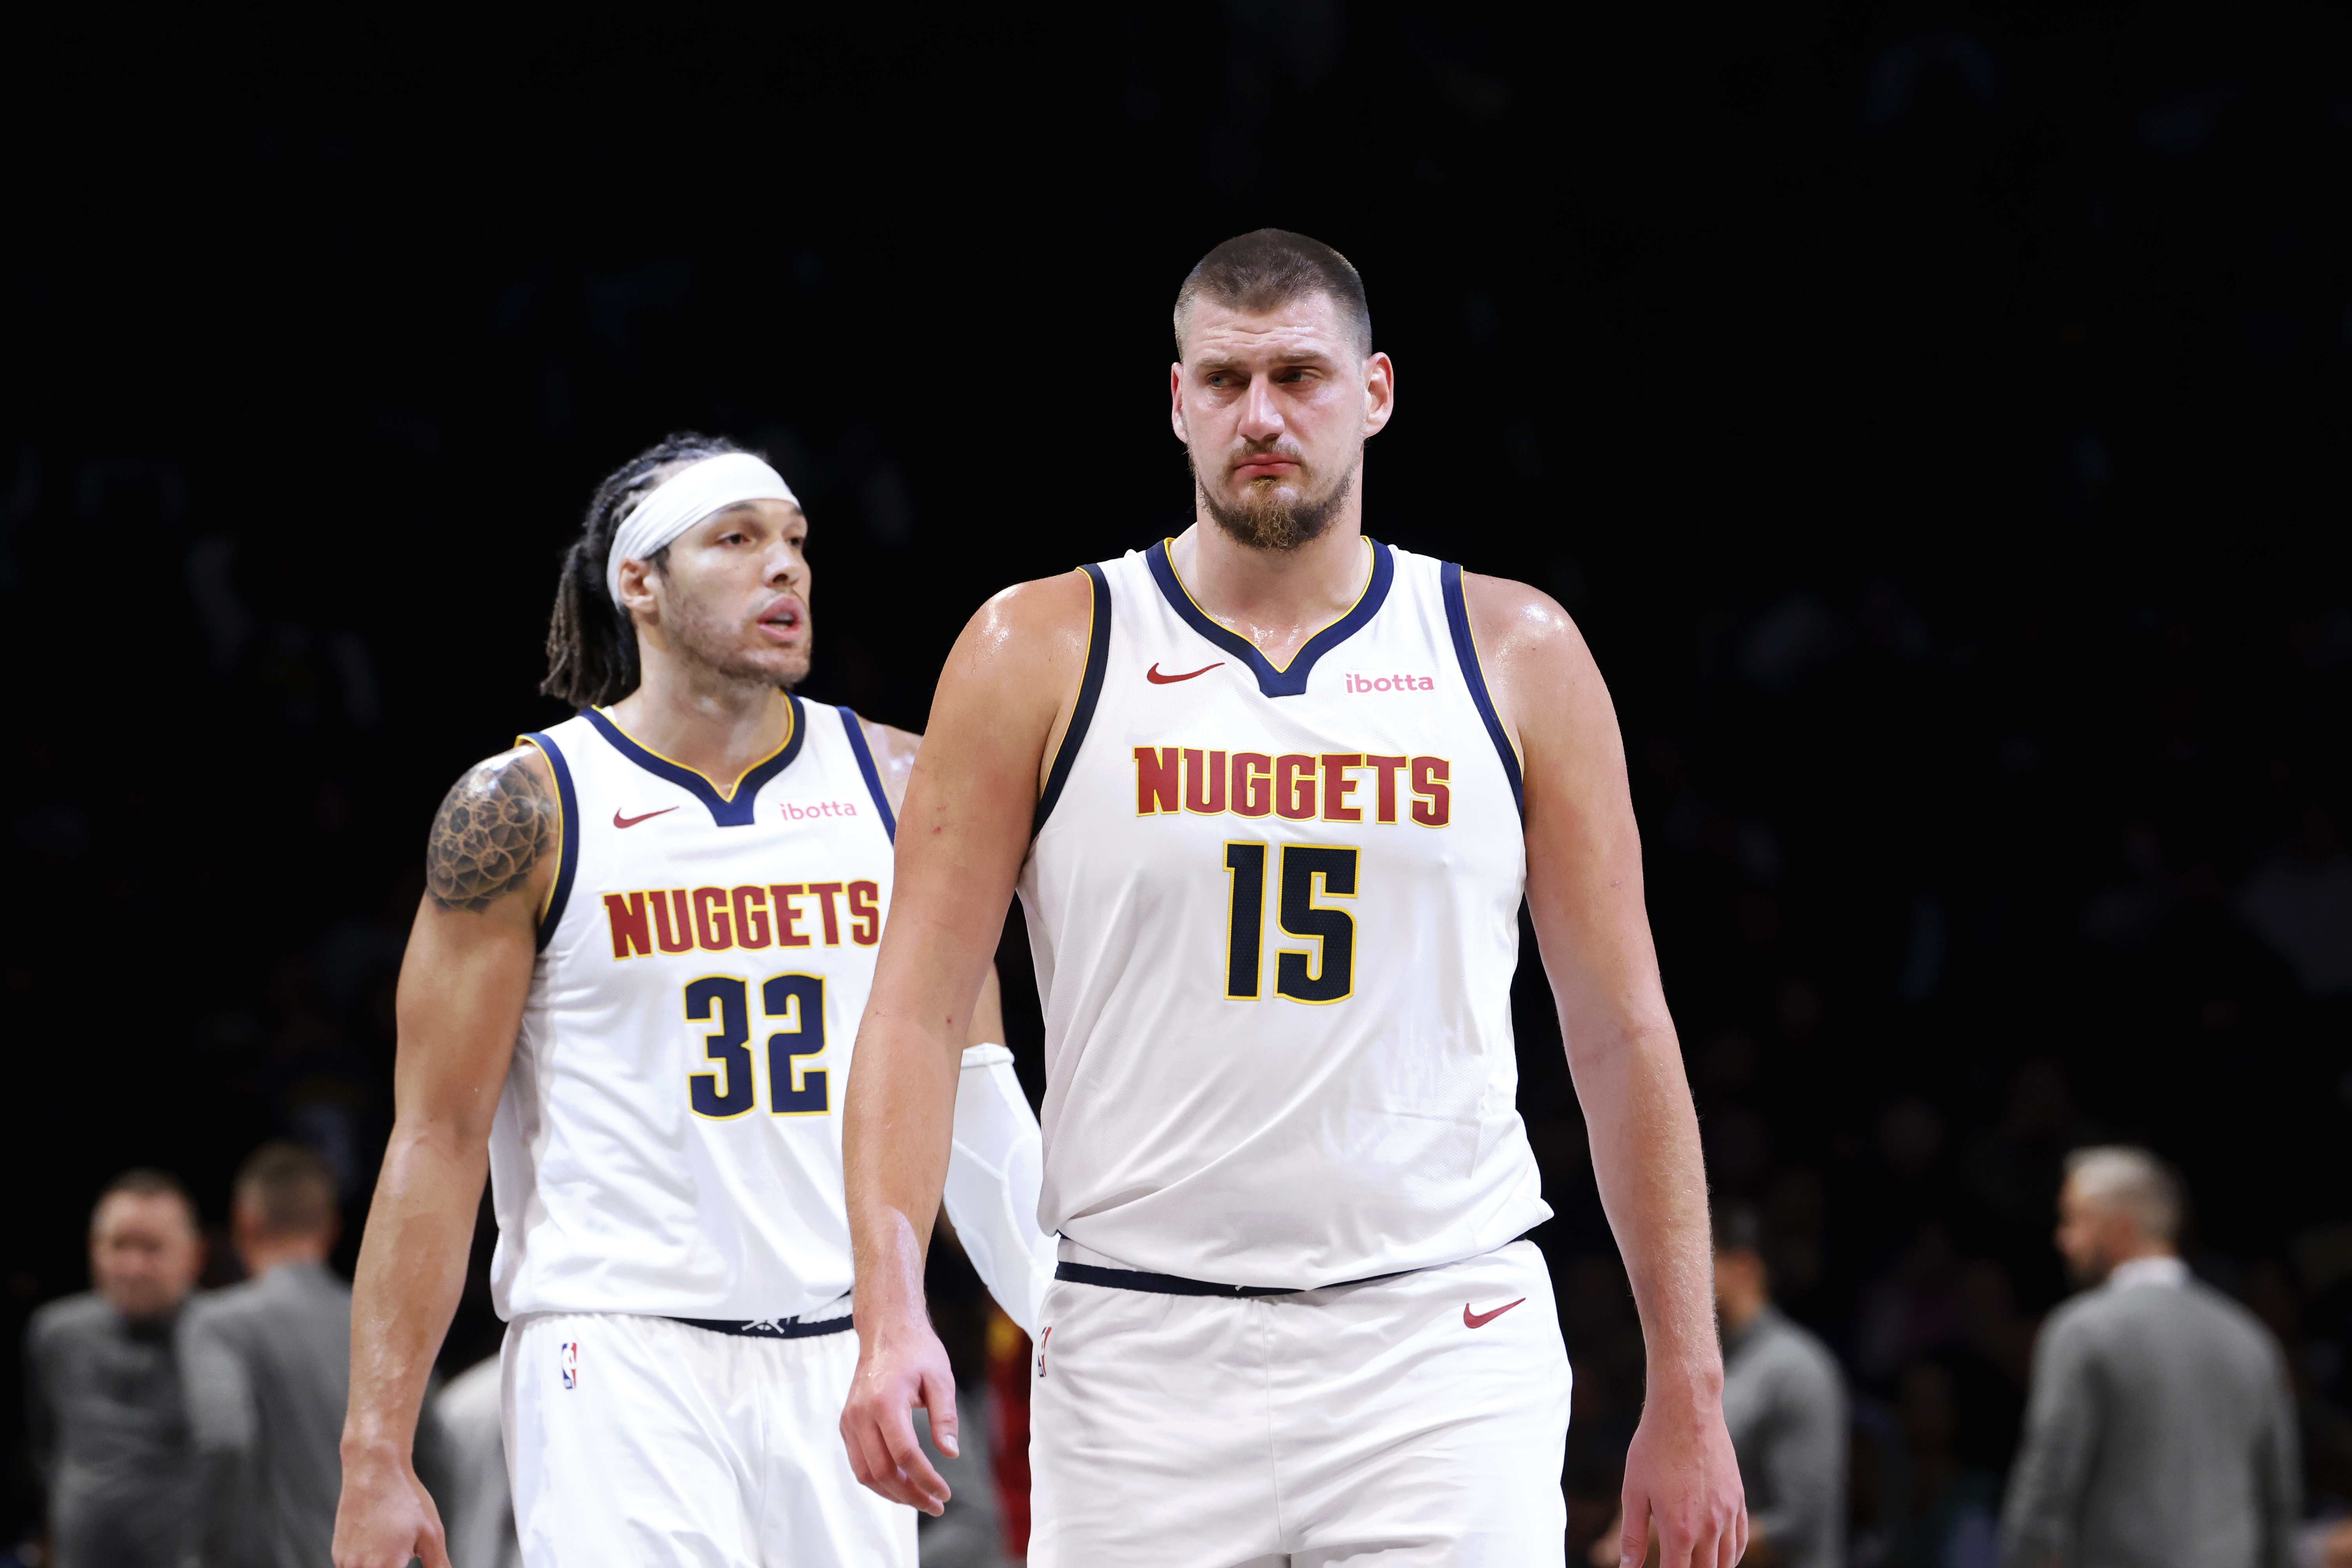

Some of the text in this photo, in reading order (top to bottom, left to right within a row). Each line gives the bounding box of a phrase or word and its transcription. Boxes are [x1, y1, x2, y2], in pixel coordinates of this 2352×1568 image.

[1345, 673, 1435, 694] ibotta
[779, 801, 857, 821] ibotta
[1132, 746, 1451, 828] NUGGETS
[603, 878, 880, 961] NUGGETS
[1223, 840, 1361, 1005] 15
[682, 971, 831, 1120] 32
